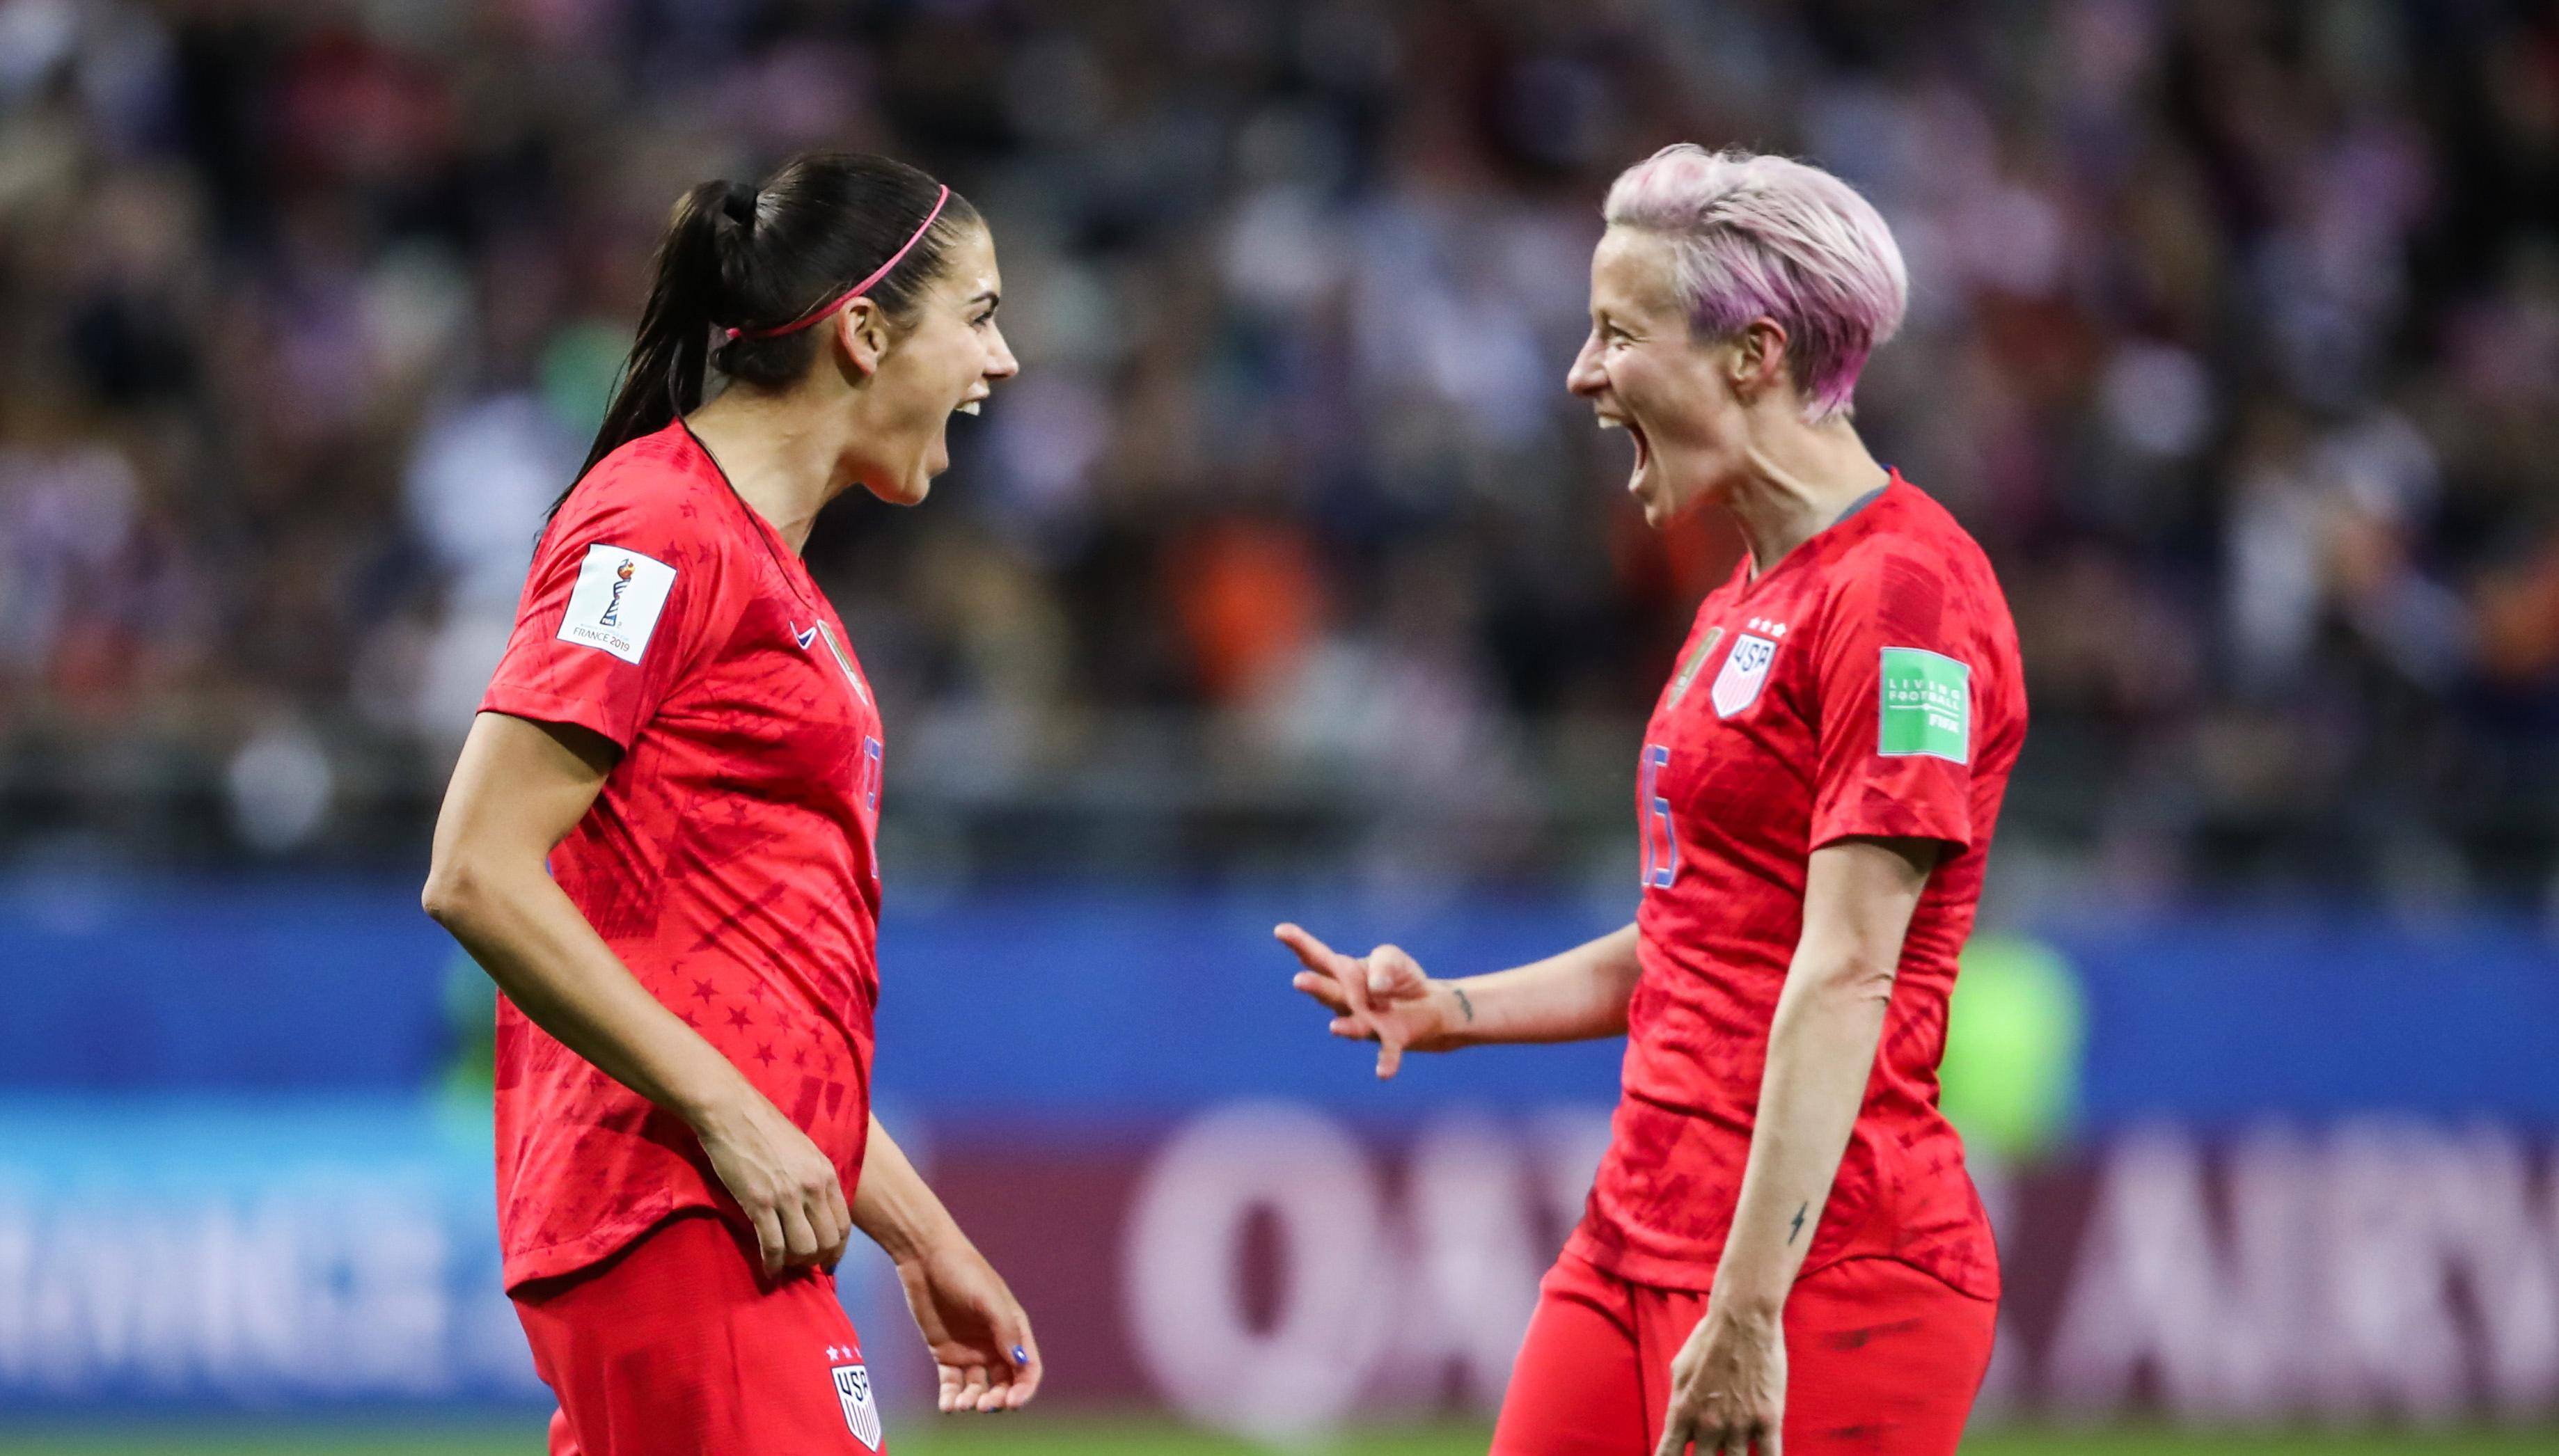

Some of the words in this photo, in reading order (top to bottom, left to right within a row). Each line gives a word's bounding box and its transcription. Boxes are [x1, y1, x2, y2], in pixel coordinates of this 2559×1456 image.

[573, 627, 610, 642] FRANCE
[610, 636, 630, 652] 2019
[1734, 640, 1770, 672] USA
[1889, 679, 1960, 699] LIVING
[1889, 690, 1960, 711] FOOTBALL
[1928, 713, 1960, 734] FIFA
[837, 1371, 868, 1402] USA
